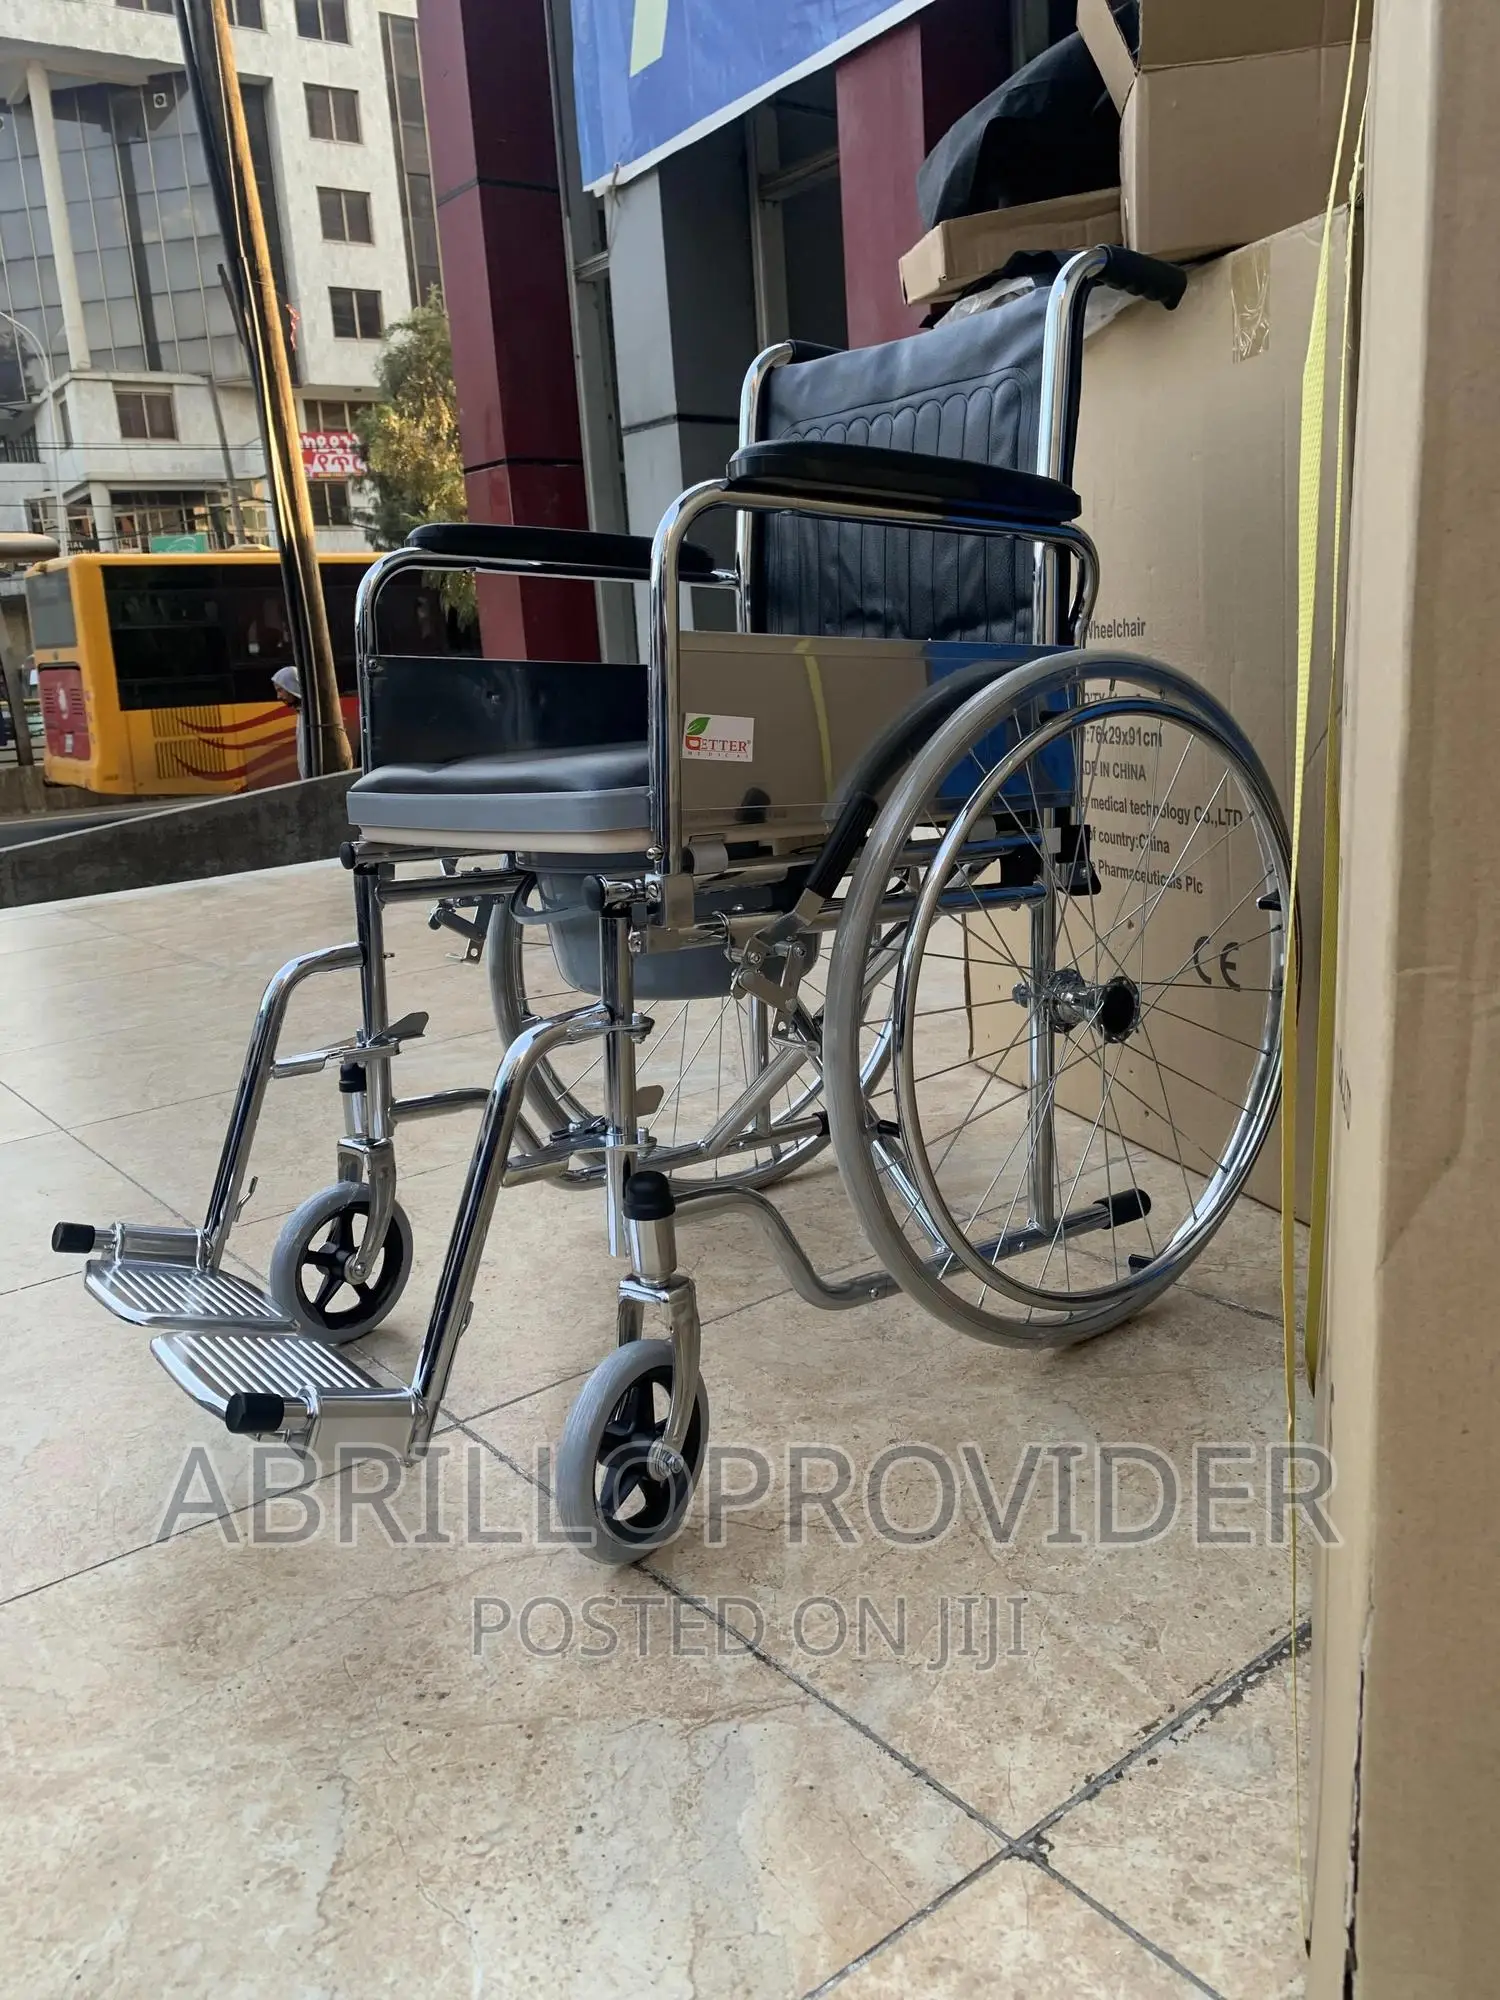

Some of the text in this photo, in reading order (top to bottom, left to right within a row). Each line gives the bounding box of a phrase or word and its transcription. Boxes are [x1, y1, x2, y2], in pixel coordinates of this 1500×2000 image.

[685, 735, 748, 752] BETTER
[1100, 761, 1110, 778] IN
[1112, 762, 1147, 781] CHINA
[1091, 796, 1127, 814] medical
[1129, 799, 1191, 826] technology
[1185, 875, 1204, 895] Plc
